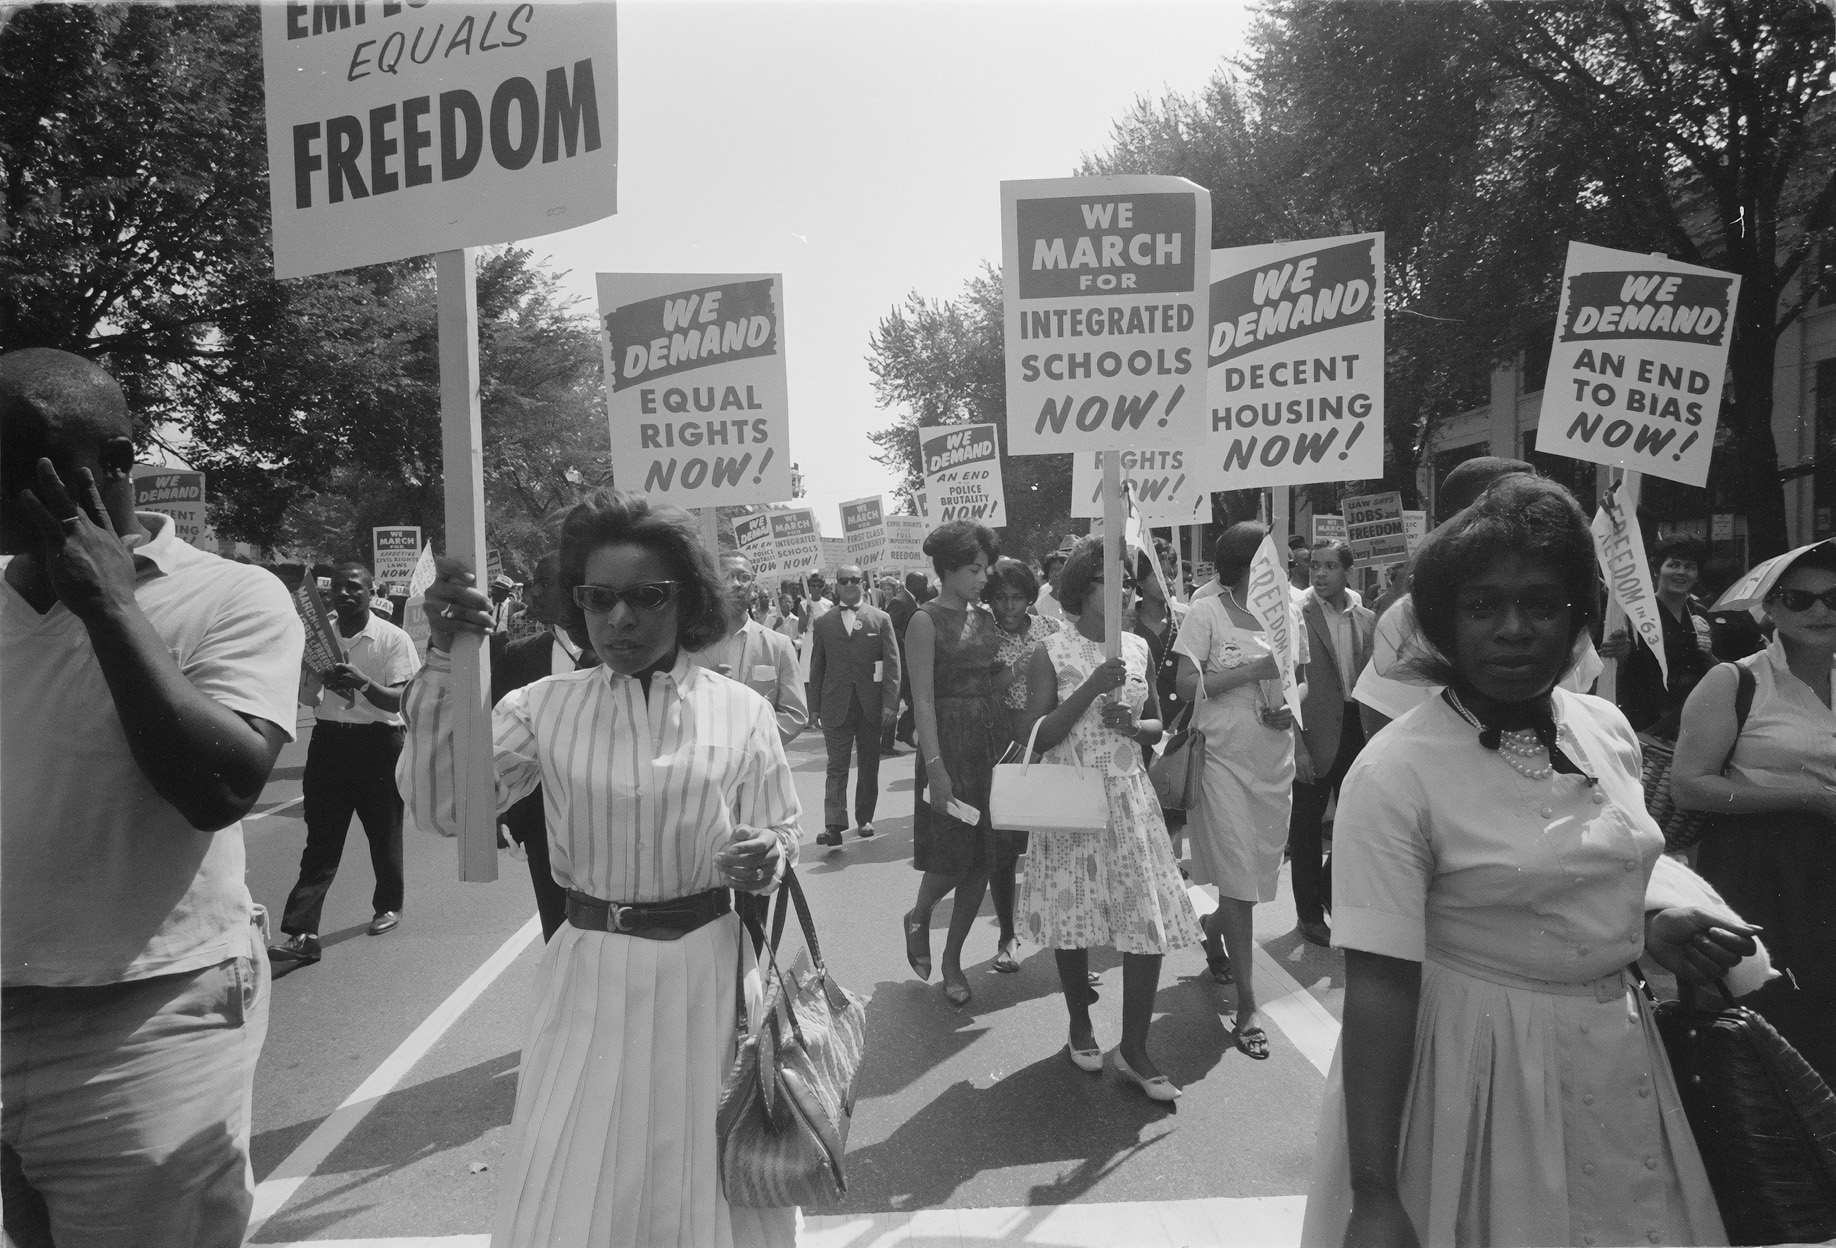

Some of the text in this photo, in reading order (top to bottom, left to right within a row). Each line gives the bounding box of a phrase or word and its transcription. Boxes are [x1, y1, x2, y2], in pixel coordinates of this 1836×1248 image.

[347, 3, 534, 82] EQUALS
[292, 57, 602, 210] FREEDOM
[1081, 202, 1133, 229] WE
[1032, 232, 1182, 270] MARCH
[1080, 273, 1137, 290] FOR
[1252, 257, 1318, 304] WE
[1620, 274, 1683, 302] WE
[663, 291, 722, 332] WE
[1020, 303, 1195, 339] INTEGRATED
[1209, 279, 1370, 357] DEMAND
[1572, 304, 1722, 335] DEMAND
[623, 315, 771, 378] DEMAND
[1021, 347, 1193, 382] SCHOOLS
[1225, 354, 1360, 392] DECENT
[1572, 348, 1710, 395] AN END
[640, 385, 763, 415] EQUAL
[1034, 384, 1186, 435] NOW!
[1212, 393, 1373, 432] HOUSING
[1572, 378, 1703, 427] TO BIAS
[640, 418, 769, 449] RIGHTS
[946, 430, 972, 450] WE
[1223, 421, 1365, 472] NOW!
[1566, 411, 1699, 462] NOW!
[644, 447, 774, 493] NOW!
[930, 440, 992, 472] DEMAND
[1094, 451, 1183, 470] RGHTS
[155, 475, 180, 488] WE
[936, 470, 990, 483] AN END
[949, 484, 982, 495] POLICE
[139, 486, 199, 503] DEMAND
[940, 494, 989, 506] BRUTALITY
[1348, 500, 1371, 510] UAW
[847, 510, 879, 525] MARCH
[941, 500, 998, 522] NOW!
[1348, 508, 1383, 524] JOBS
[775, 519, 810, 533] MARCH
[1349, 522, 1402, 541] FREEDOM
[775, 535, 816, 548] INTEGRATED
[777, 544, 818, 558] SCHOOLS
[783, 553, 818, 570] NOW!
[855, 549, 885, 566] NOW!
[1249, 556, 1288, 655] FREEDOM
[1635, 606, 1646, 618] IN
[1640, 618, 1660, 645] '63
